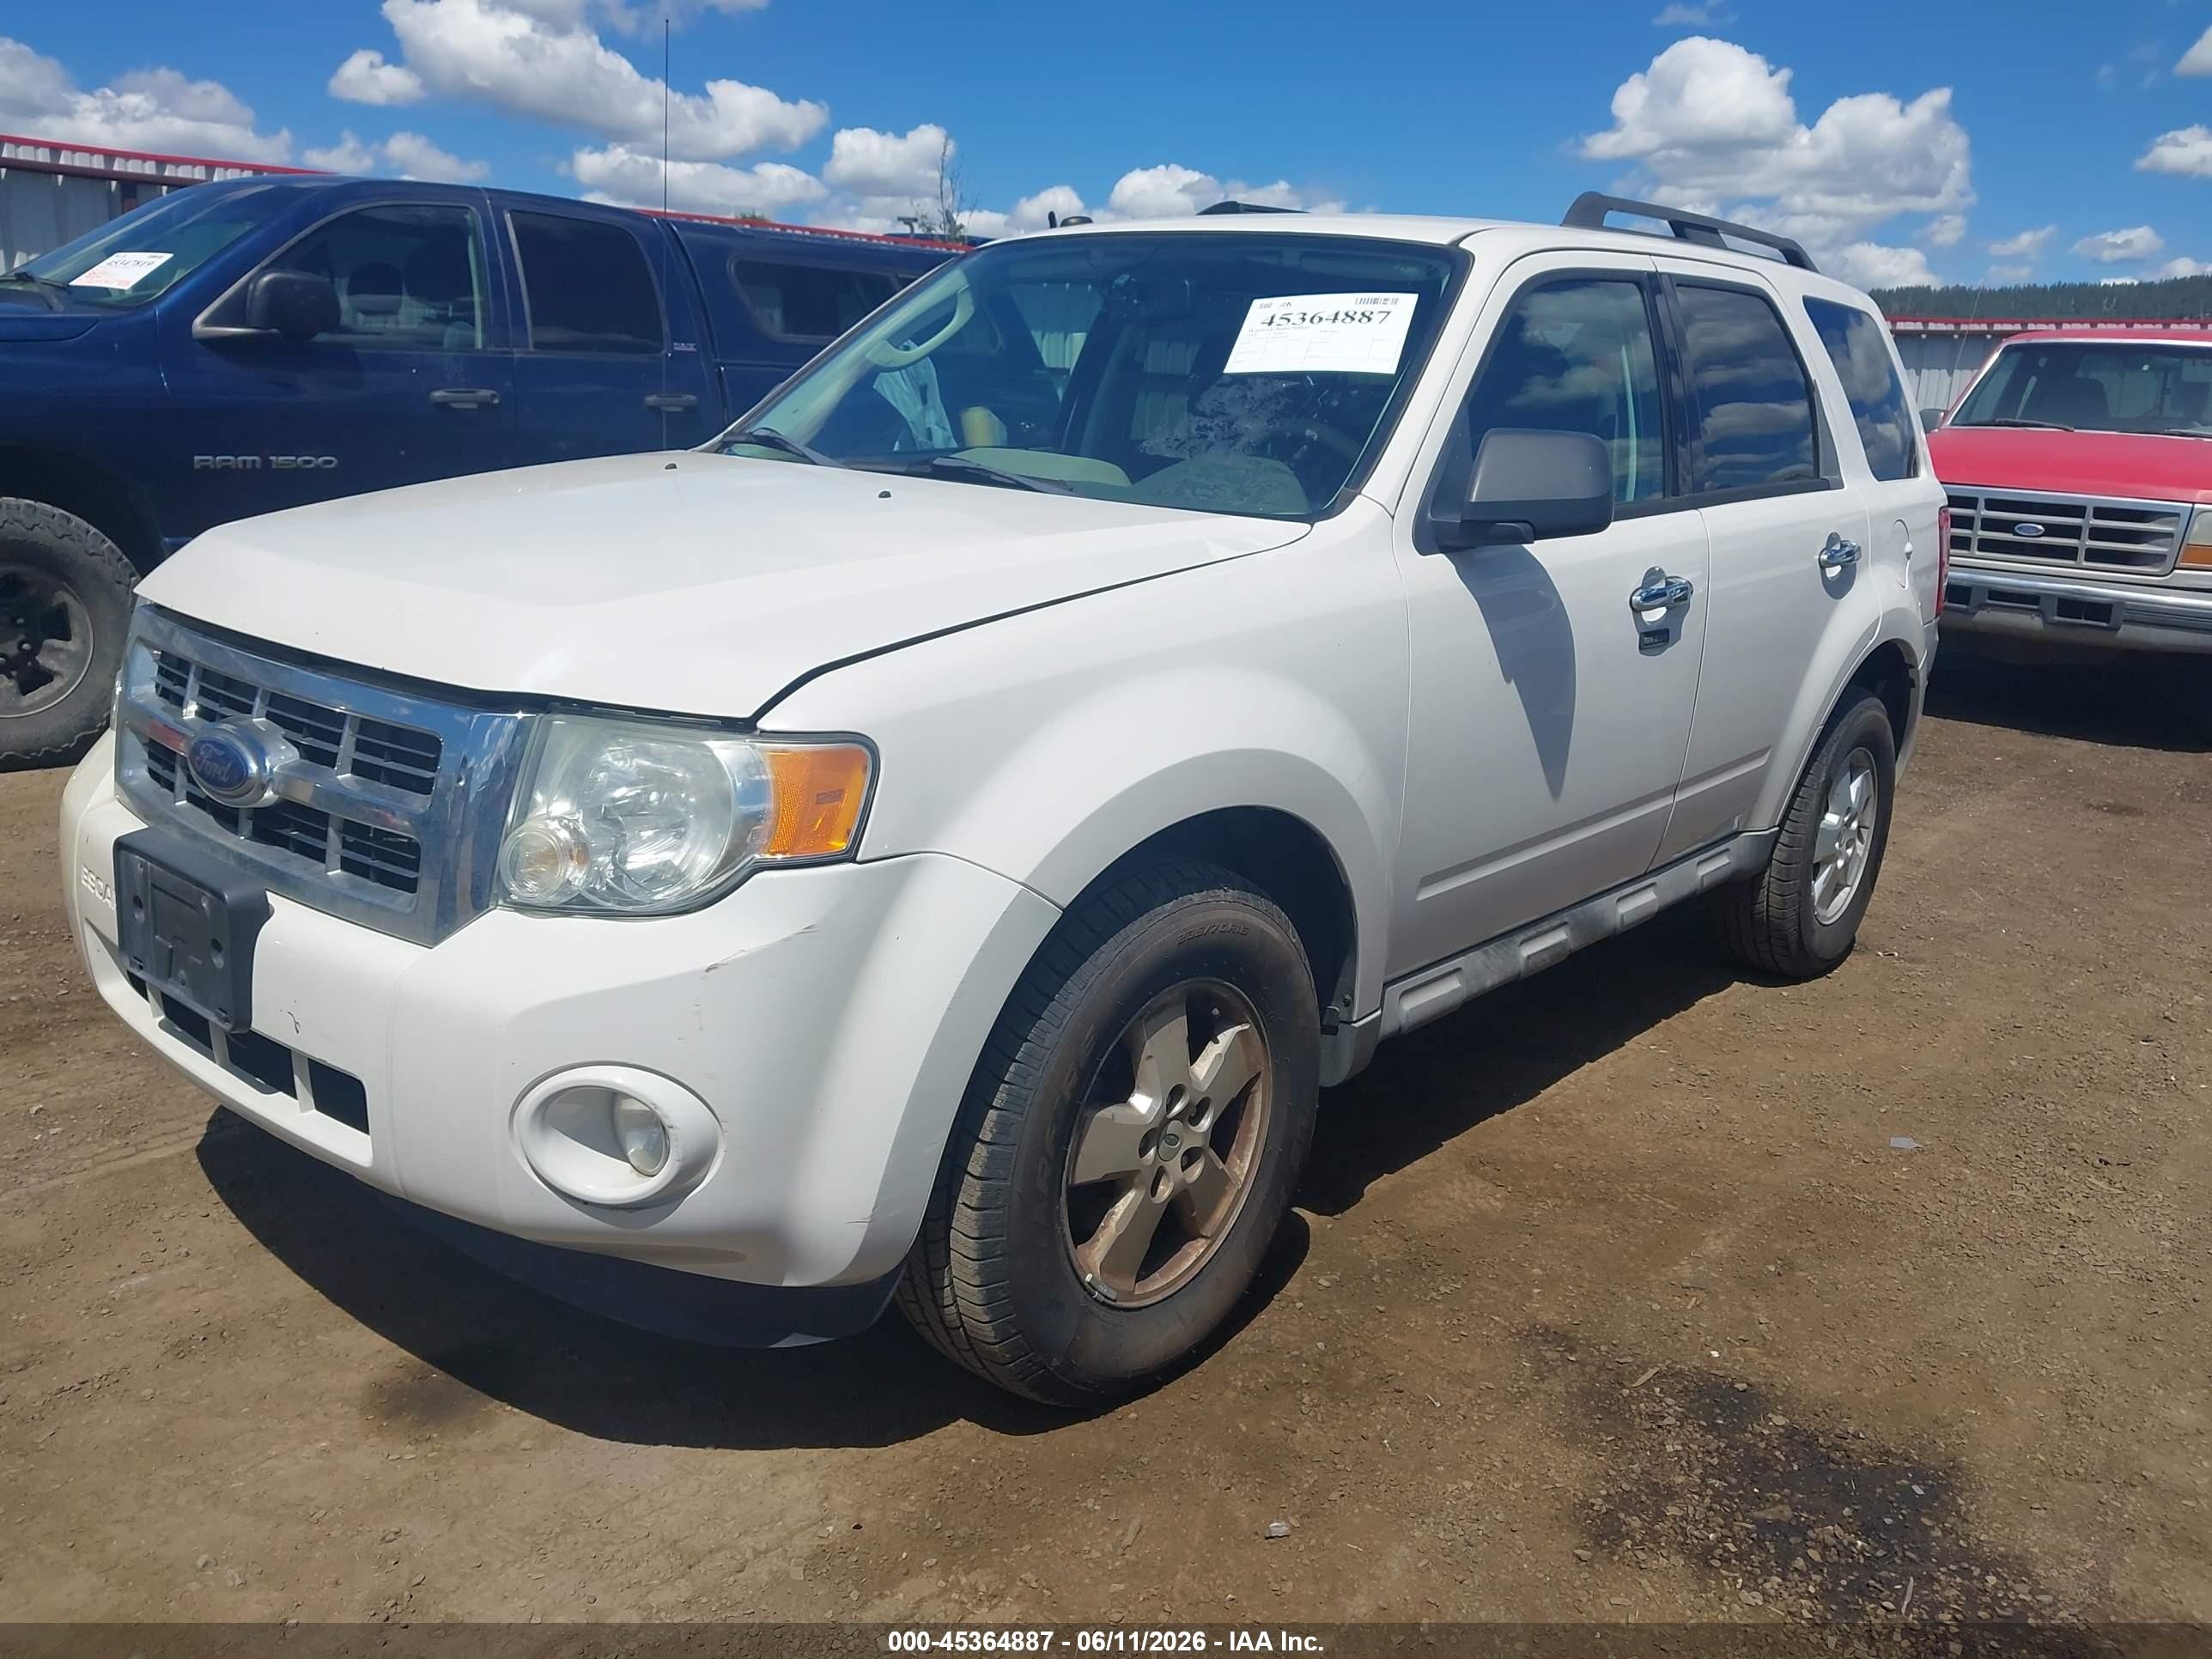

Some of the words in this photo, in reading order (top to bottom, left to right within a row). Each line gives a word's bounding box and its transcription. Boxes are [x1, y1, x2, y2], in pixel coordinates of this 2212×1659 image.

[1260, 309, 1392, 327] 45364887
[193, 455, 262, 470] RAM
[268, 455, 339, 470] 1500
[194, 743, 232, 783] Ford
